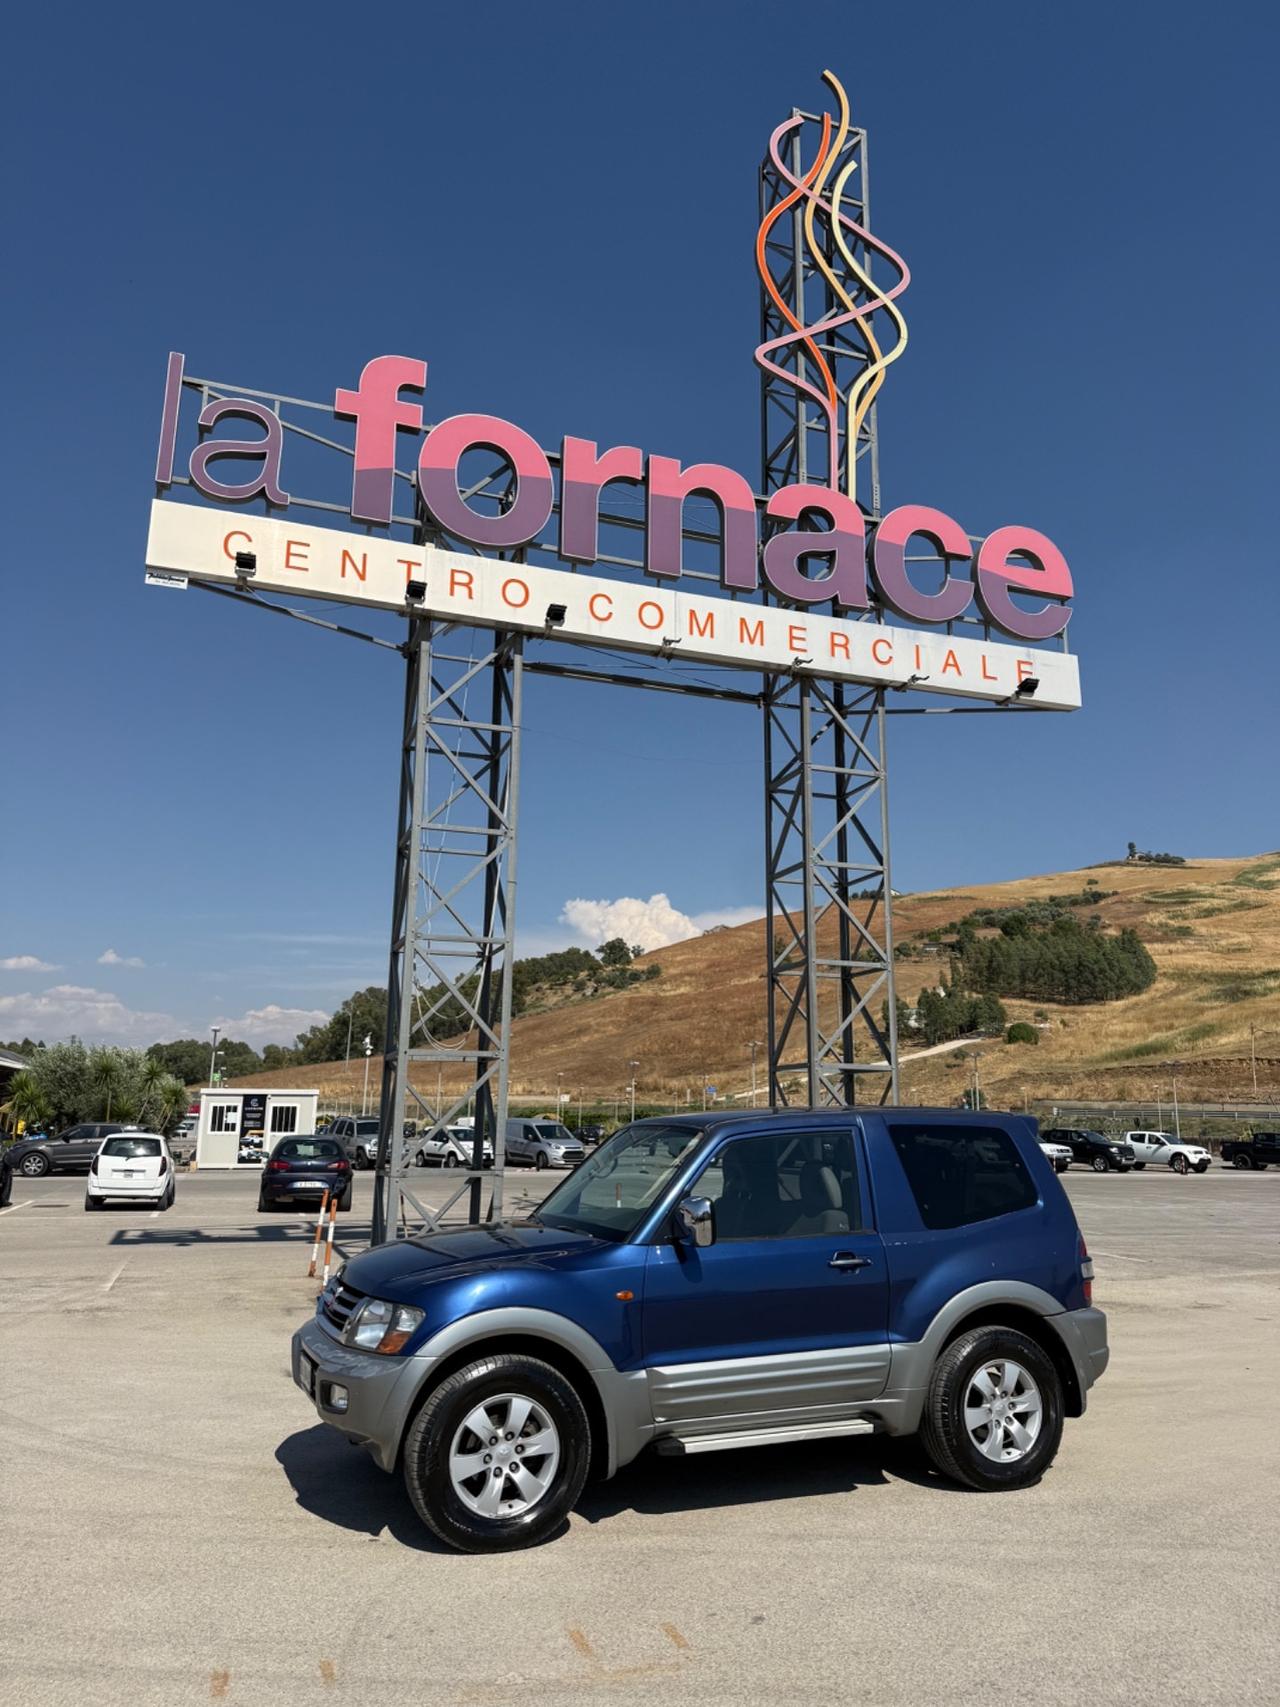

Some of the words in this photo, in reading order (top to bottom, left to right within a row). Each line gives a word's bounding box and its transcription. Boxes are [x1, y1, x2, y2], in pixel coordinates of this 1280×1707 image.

[153, 351, 290, 506] la
[334, 354, 1074, 640] fornace
[222, 530, 530, 609] CENTRO
[588, 593, 1036, 686] COMMERCIALE
